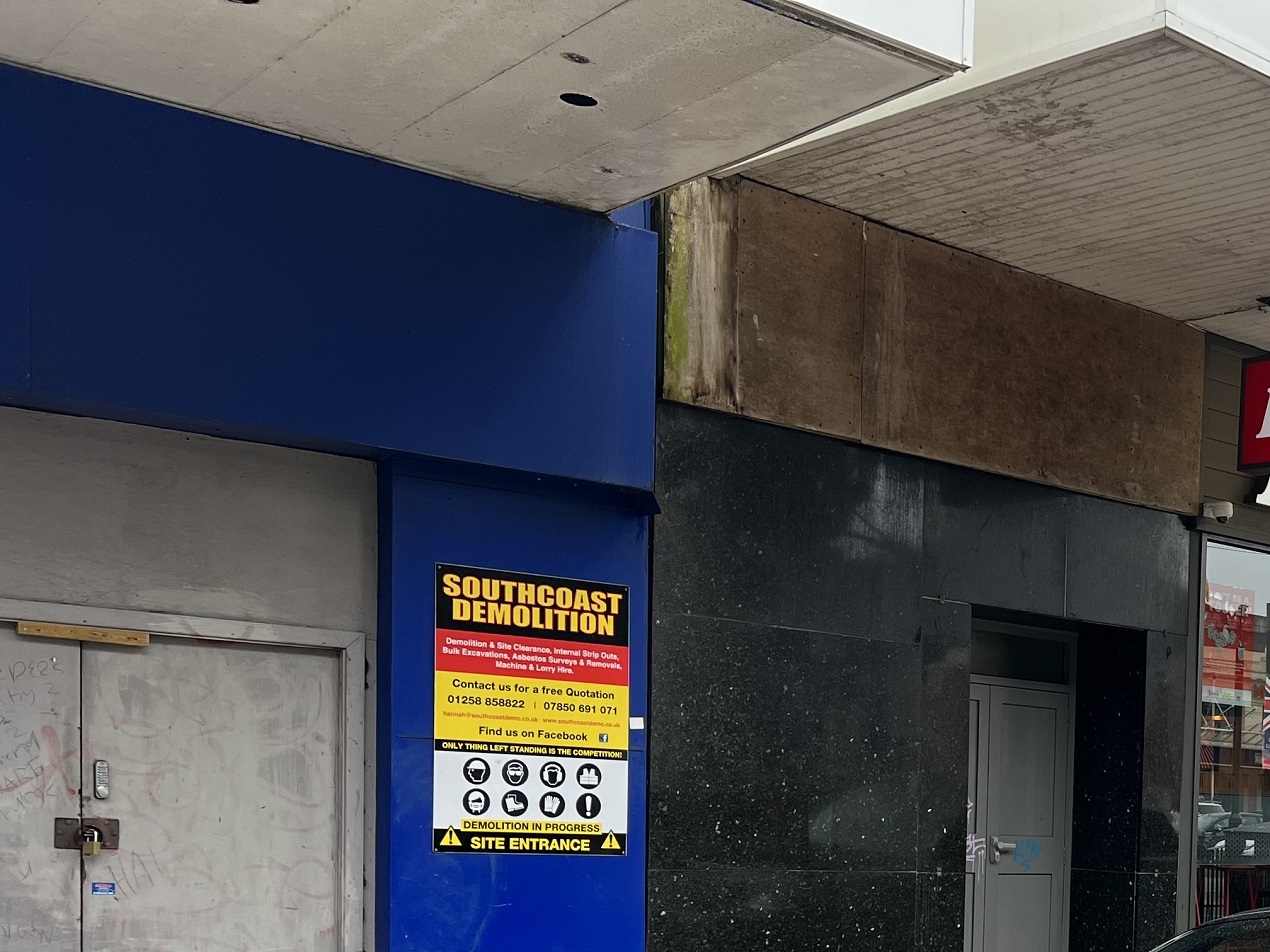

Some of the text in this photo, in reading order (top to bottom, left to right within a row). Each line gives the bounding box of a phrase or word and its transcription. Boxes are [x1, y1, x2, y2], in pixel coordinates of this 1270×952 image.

[442, 573, 623, 614] SOUTHCOAST
[452, 598, 615, 636] DEMOLITION
[442, 647, 460, 655] Bulk
[462, 648, 510, 660] Excavations,
[512, 653, 547, 663] Asbestos
[548, 656, 578, 667] Surveys
[586, 660, 623, 670] Removals,
[446, 637, 487, 648] Demolition
[497, 642, 512, 650] Site
[513, 643, 552, 654] Clearance,
[554, 647, 581, 657] Internal
[582, 650, 599, 660] Strip
[600, 652, 620, 661] Outs,
[496, 661, 527, 671] Machine
[536, 665, 556, 674] Lorry
[557, 666, 574, 674] Hire.
[452, 679, 615, 700] Contact us for a free Quotation
[447, 695, 618, 715] 01258 858822 07850 691 071
[479, 726, 502, 736] Find
[505, 729, 518, 737] us
[521, 730, 534, 738] on
[538, 730, 588, 742] Facebook
[489, 744, 508, 752] LEFT
[510, 745, 547, 754] STANDING
[463, 820, 600, 832] DEMOLITION IN PROGRESS
[470, 836, 591, 851] SITE ENTRANCE
